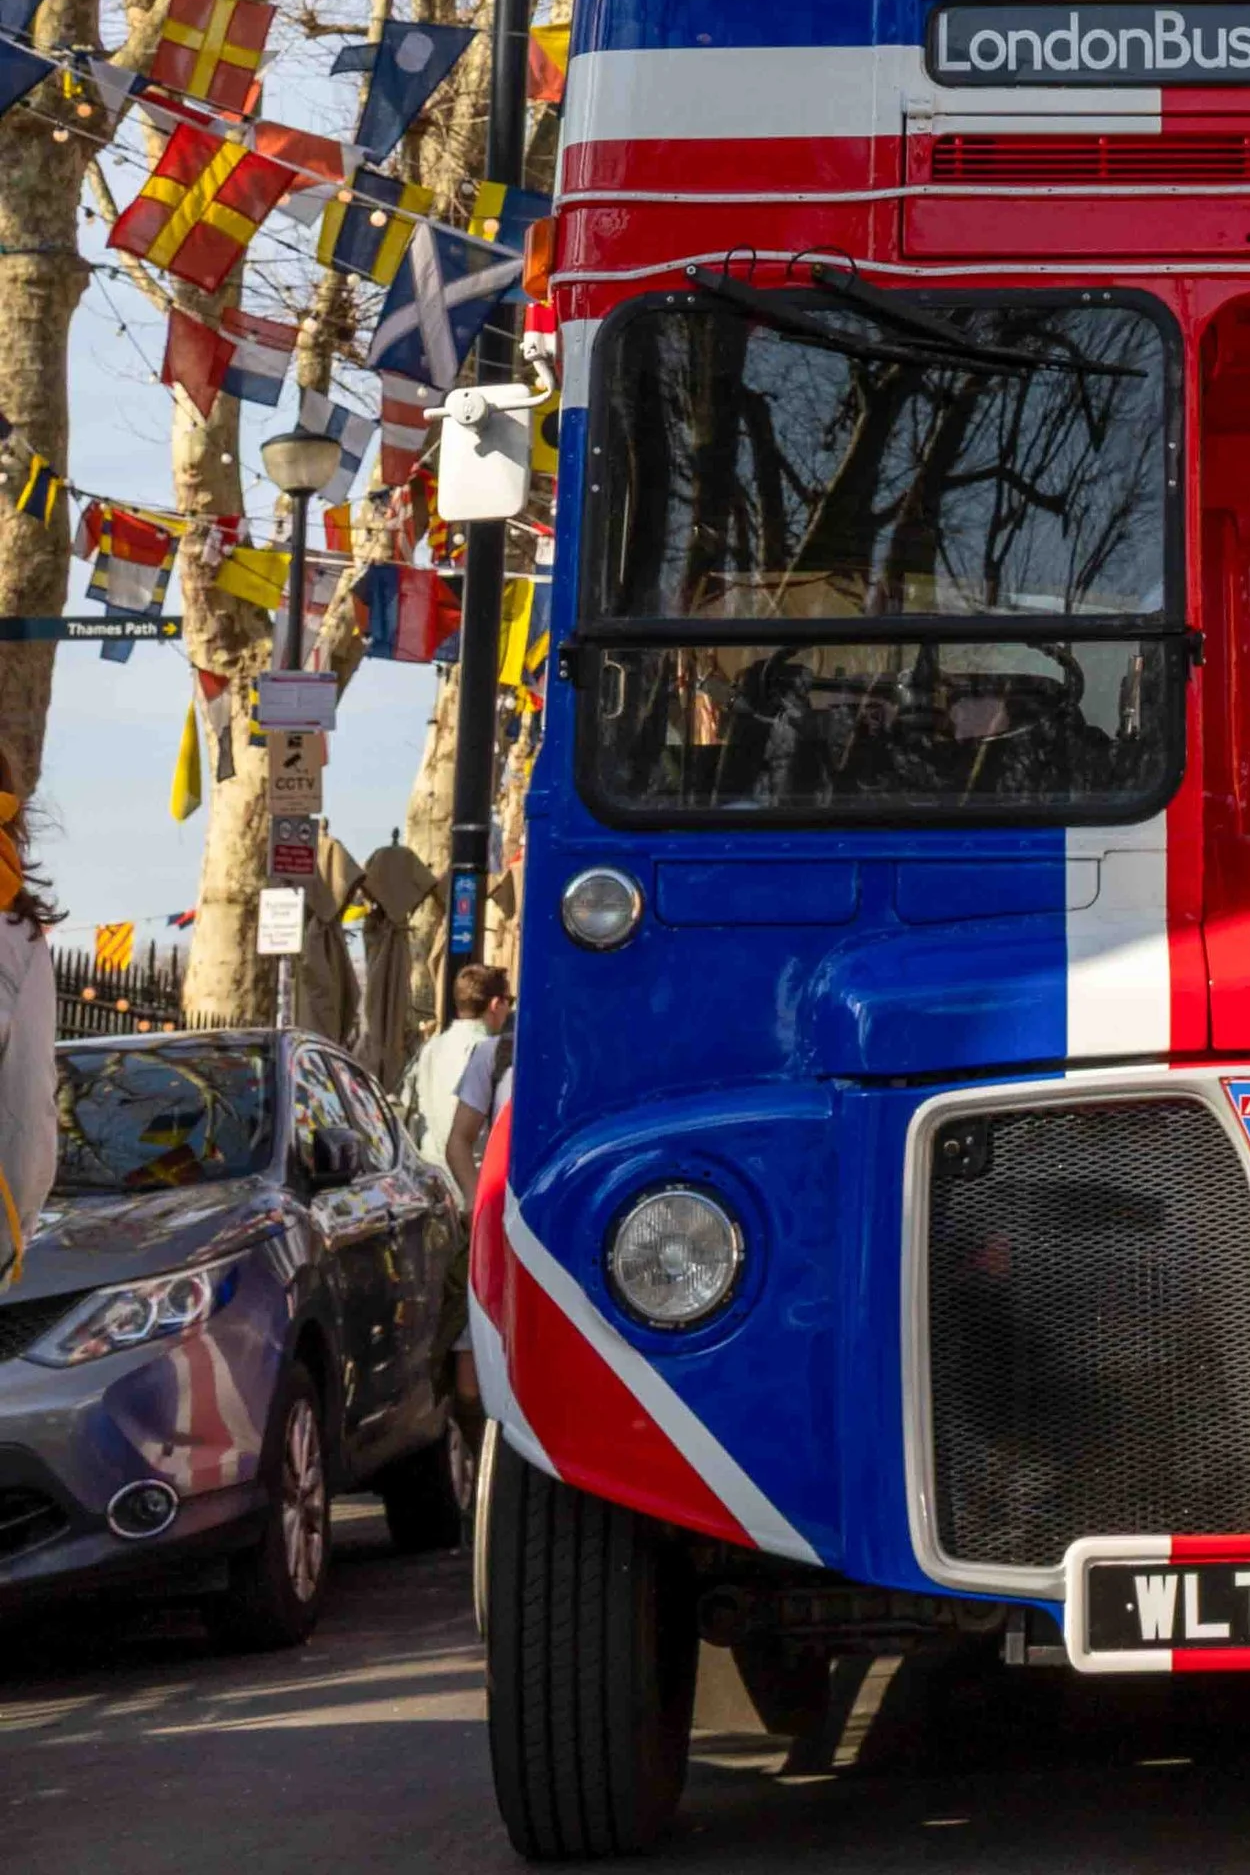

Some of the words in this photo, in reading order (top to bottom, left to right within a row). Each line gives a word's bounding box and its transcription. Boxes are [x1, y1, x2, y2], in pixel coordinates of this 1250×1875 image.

[67, 622, 122, 636] Thames
[125, 622, 157, 636] Path
[275, 776, 316, 791] CCTV
